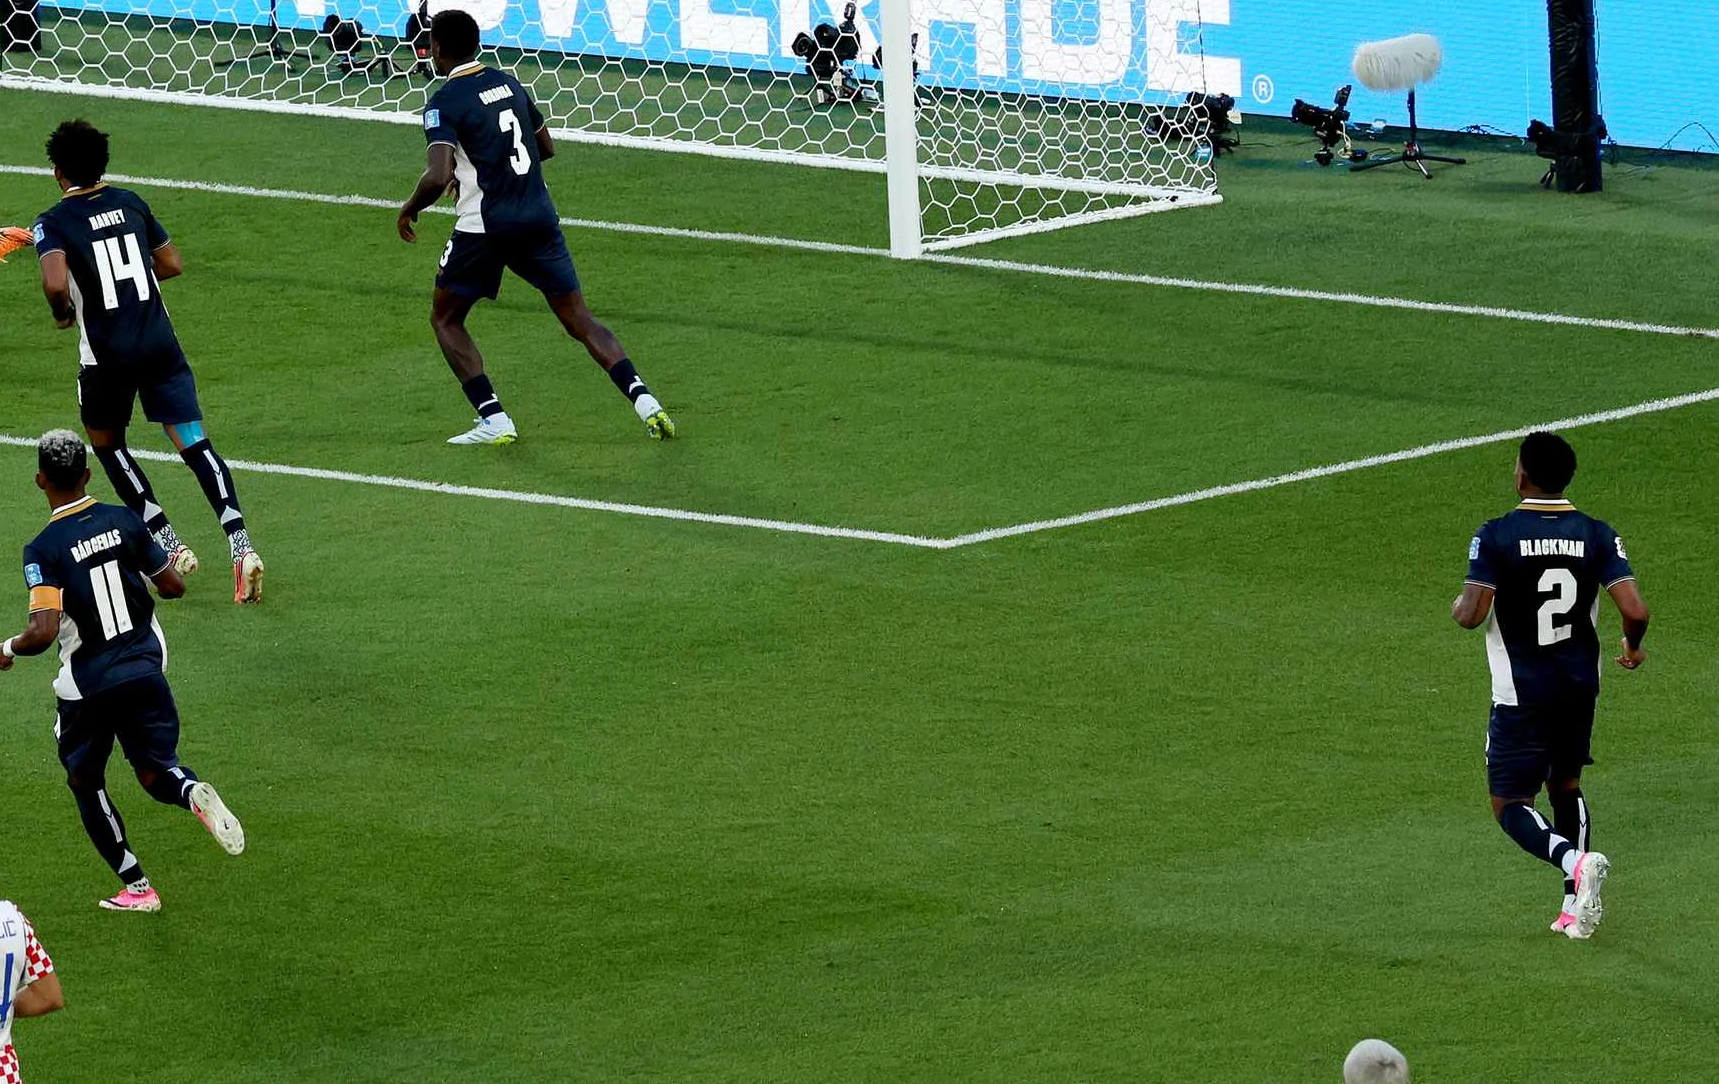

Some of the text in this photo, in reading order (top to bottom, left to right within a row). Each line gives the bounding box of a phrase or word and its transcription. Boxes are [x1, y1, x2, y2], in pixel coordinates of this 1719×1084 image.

[498, 108, 532, 176] 3
[88, 208, 125, 232] HARVEY
[439, 239, 453, 268] 3
[91, 232, 150, 310] 14
[1519, 539, 1585, 558] BLACKMAN
[88, 559, 134, 642] 11
[1537, 568, 1578, 646] 2
